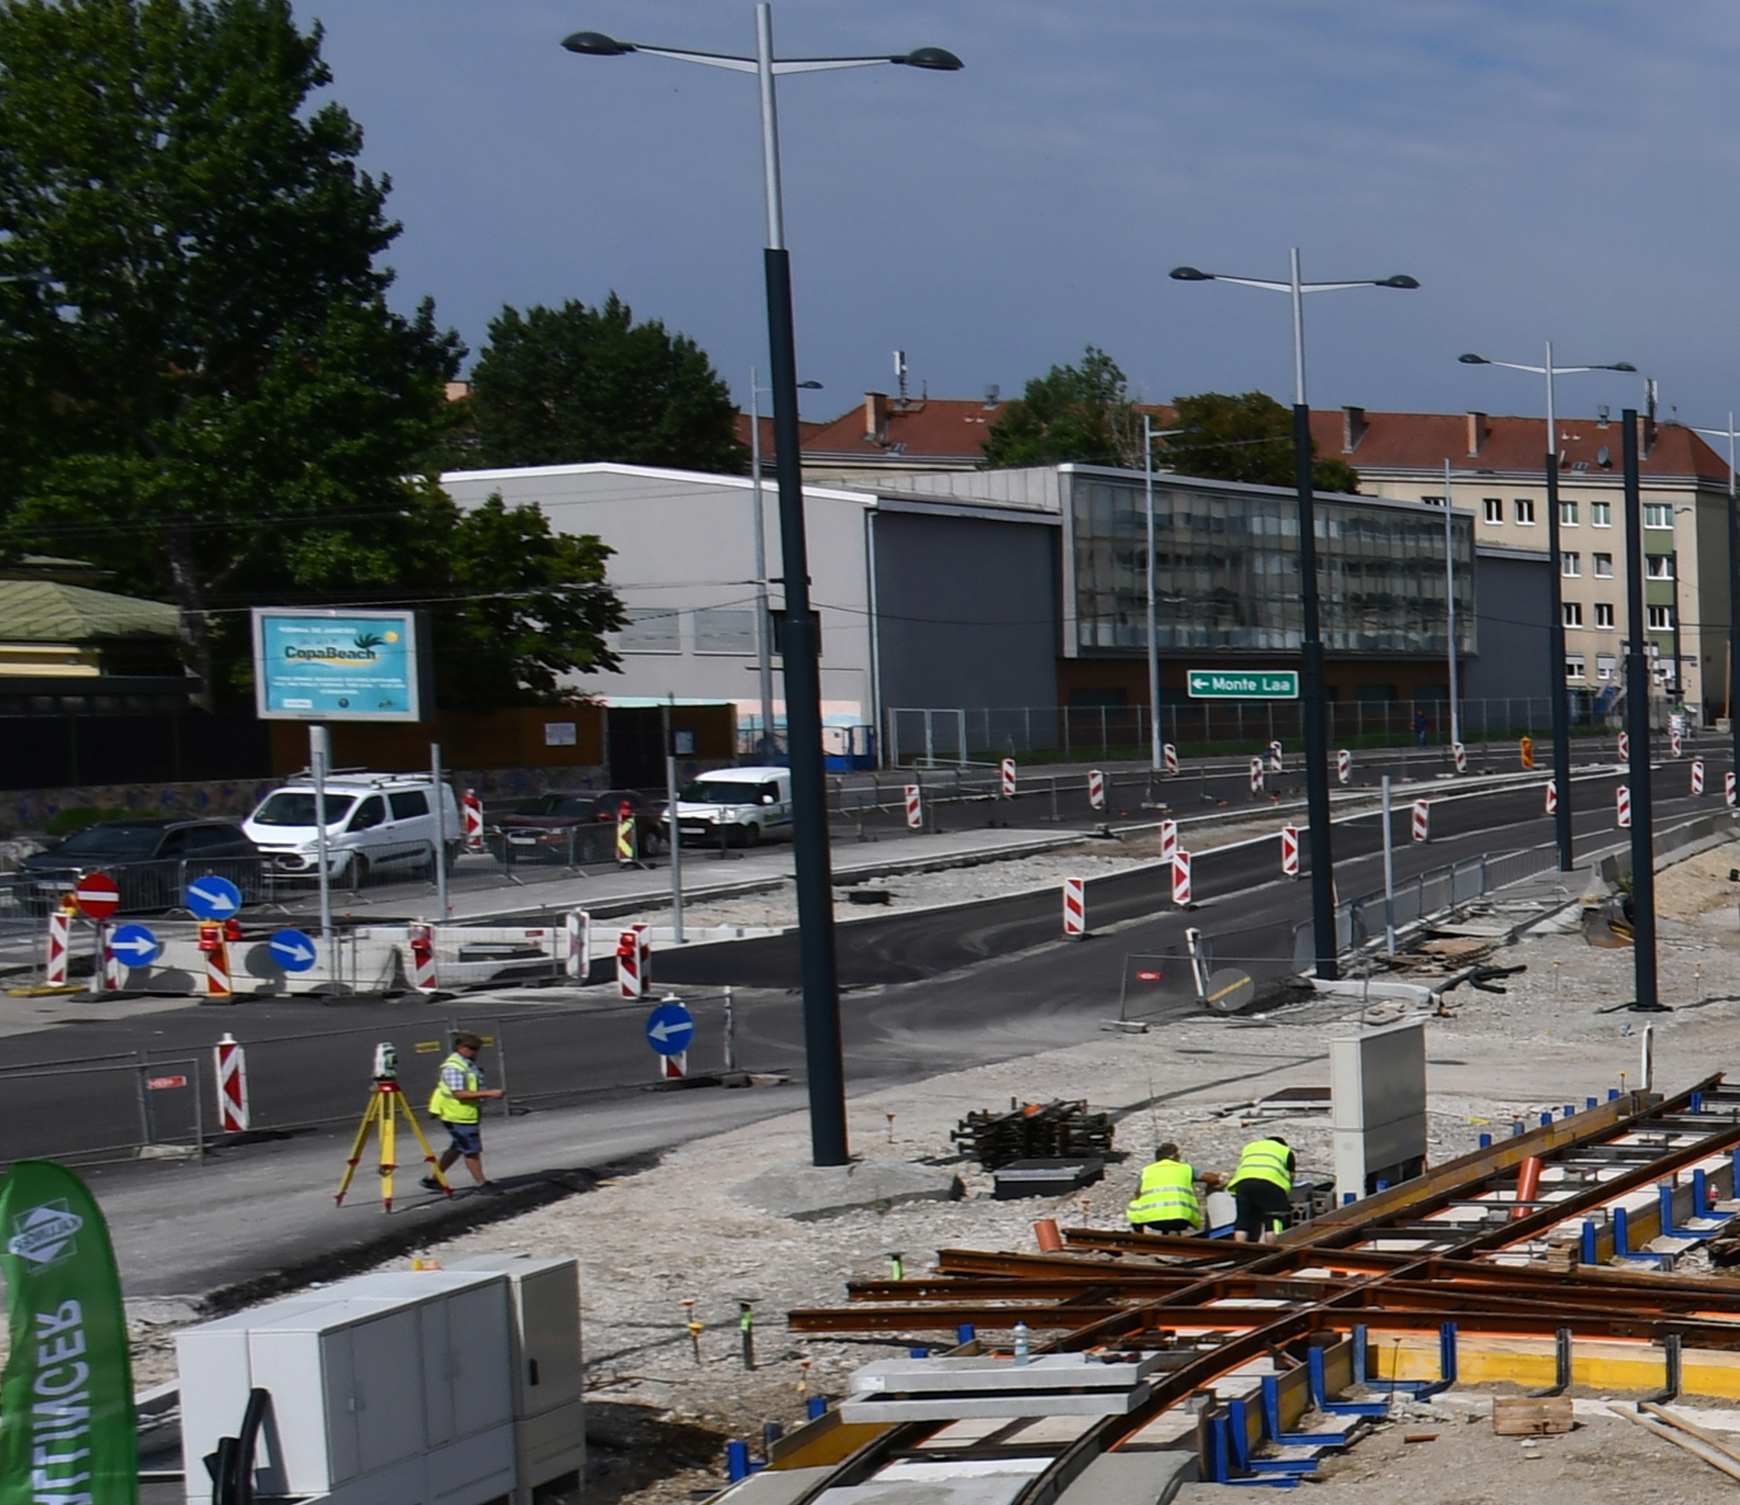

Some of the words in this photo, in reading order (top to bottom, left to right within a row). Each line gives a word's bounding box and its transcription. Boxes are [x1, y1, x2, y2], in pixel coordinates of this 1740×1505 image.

[284, 645, 376, 661] CopaBeach
[1212, 677, 1257, 691] Monte
[1262, 678, 1291, 691] Laa
